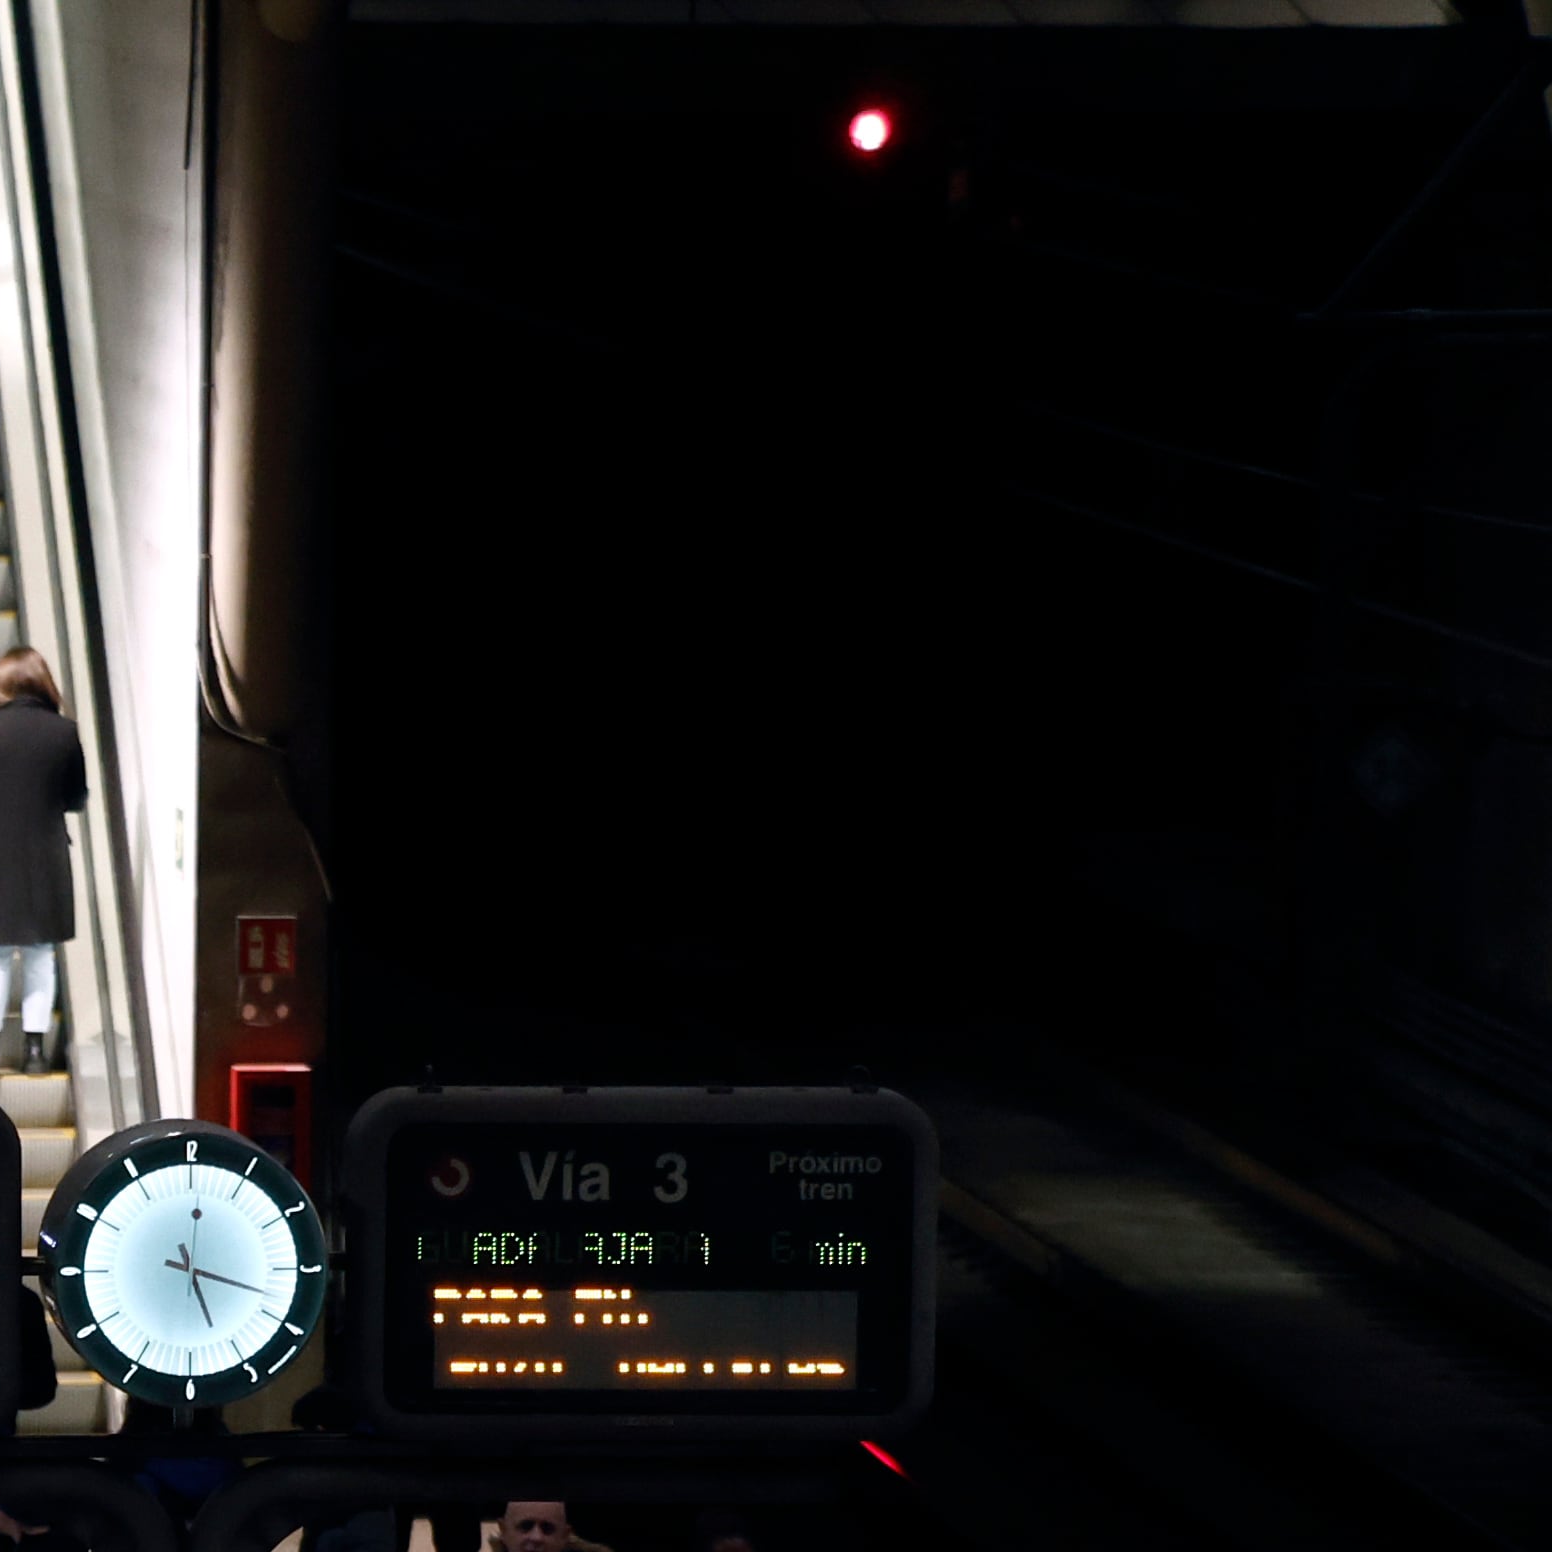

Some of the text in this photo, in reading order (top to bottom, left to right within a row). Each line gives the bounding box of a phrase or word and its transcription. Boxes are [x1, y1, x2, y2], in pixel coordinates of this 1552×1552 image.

[185, 1139, 199, 1163] 12
[768, 1149, 883, 1176] Próximo
[517, 1148, 690, 1204] Vía 3
[798, 1178, 854, 1202] tren
[283, 1200, 306, 1219] 2
[808, 1232, 870, 1266] min
[299, 1263, 323, 1274] 3
[185, 1378, 197, 1402] 6
